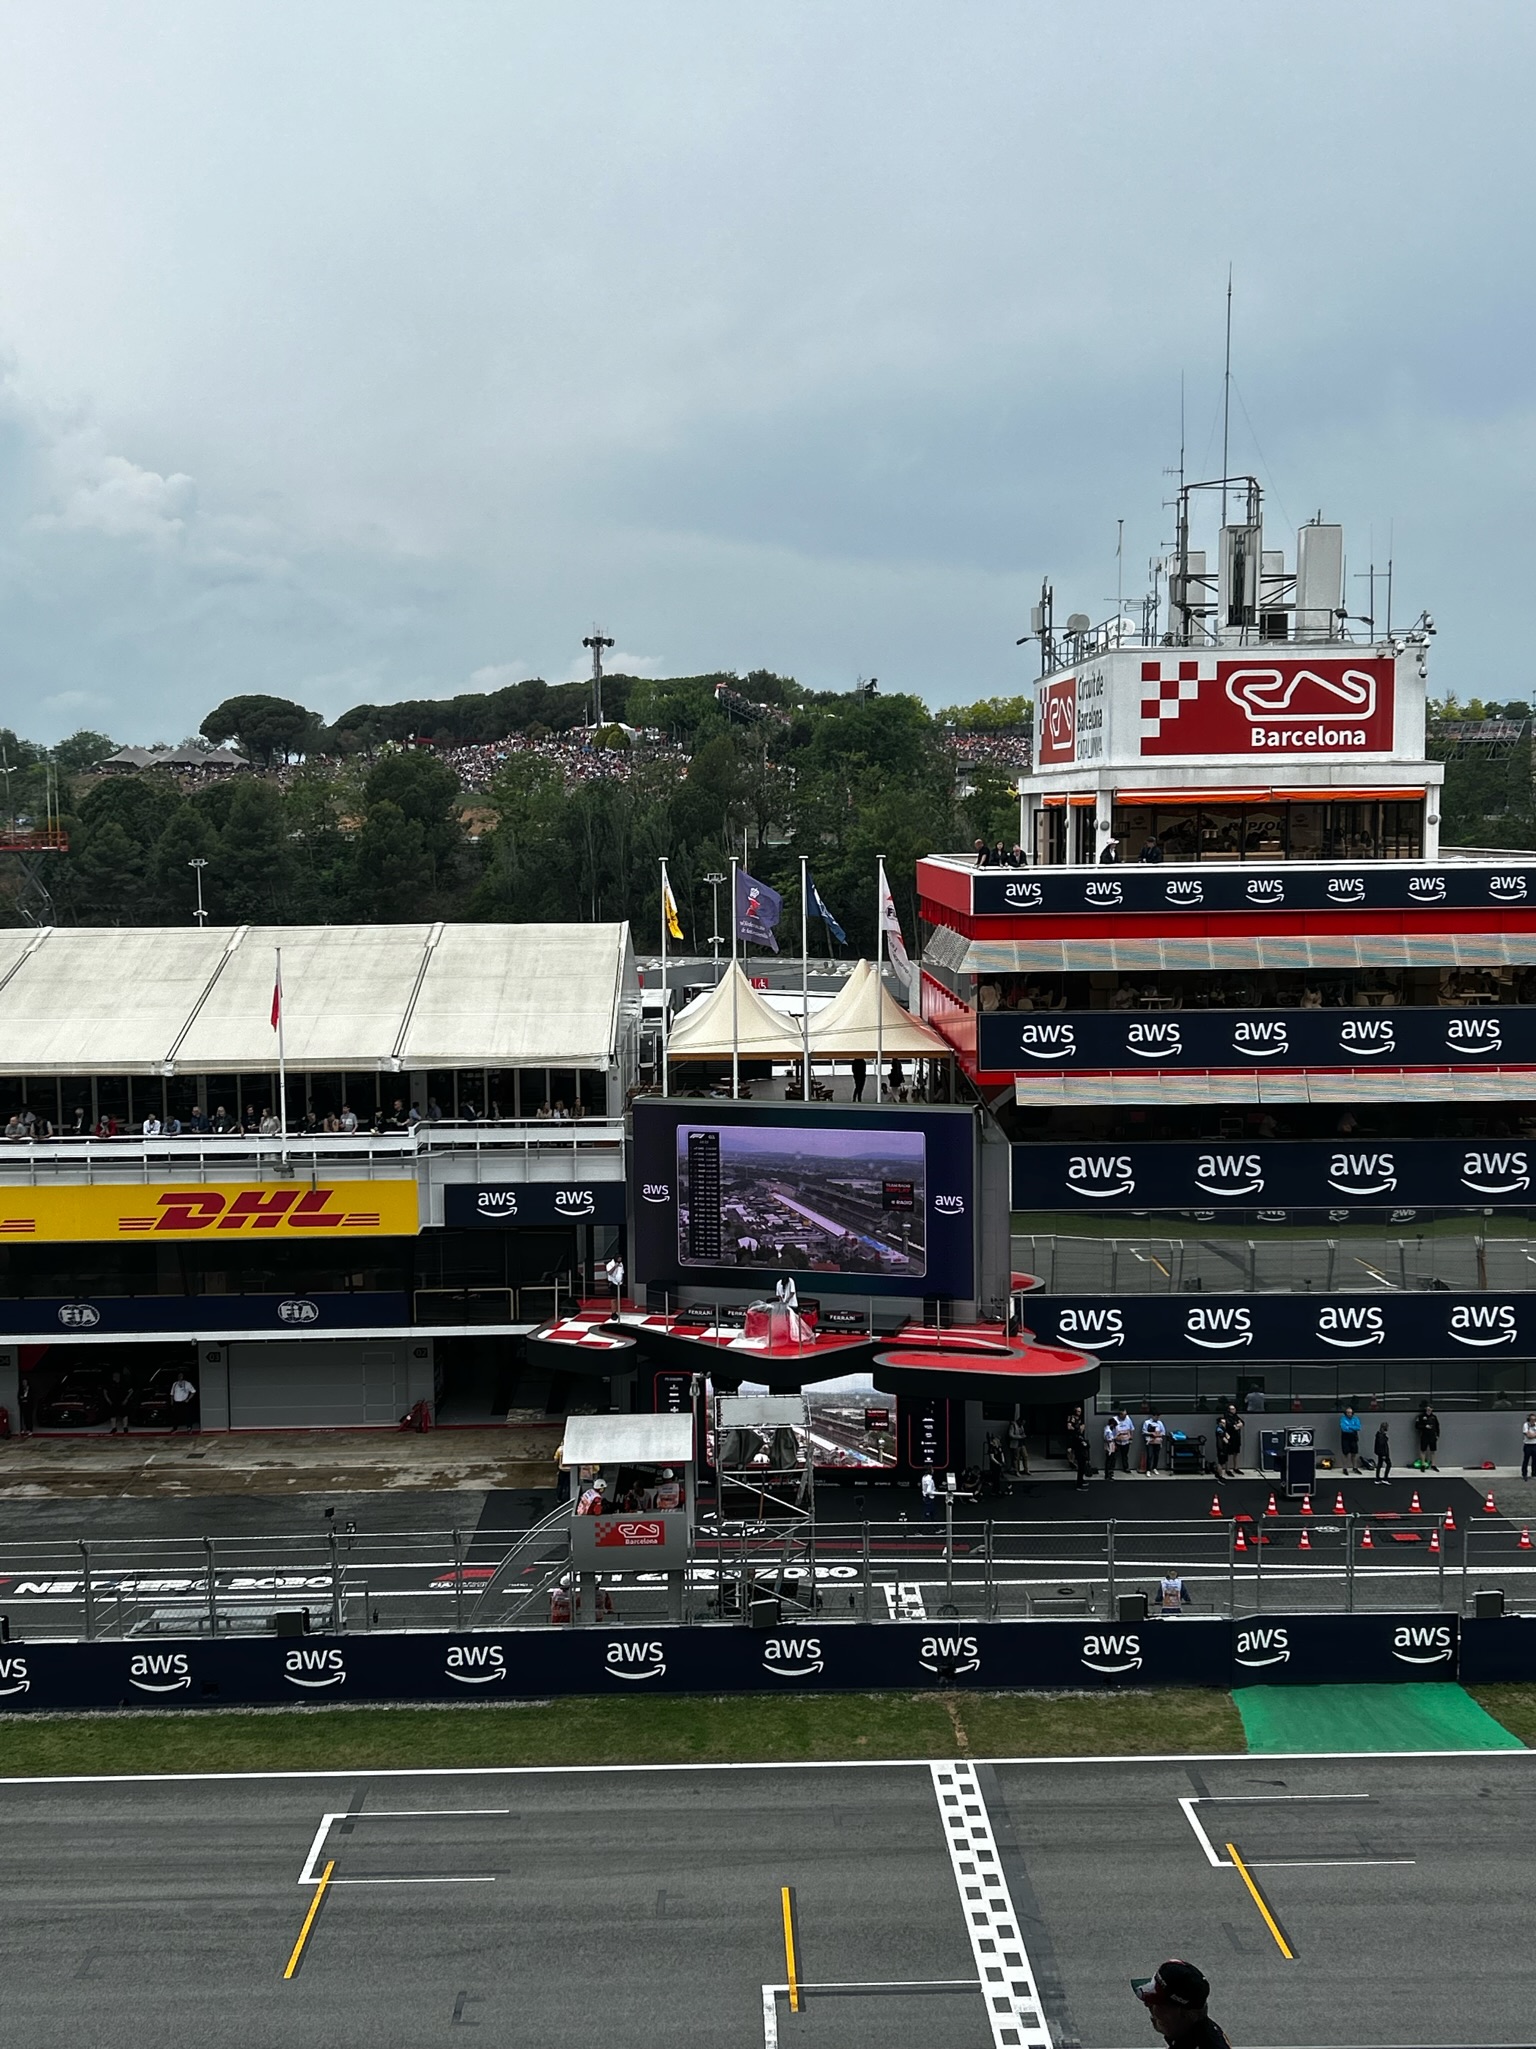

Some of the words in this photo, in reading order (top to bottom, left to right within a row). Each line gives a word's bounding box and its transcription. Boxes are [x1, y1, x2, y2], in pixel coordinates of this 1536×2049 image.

[1077, 706, 1103, 732] Barcelona
[1251, 726, 1366, 747] Barcelona
[1005, 883, 1042, 897] aws
[1085, 882, 1122, 896] aws
[1166, 881, 1203, 895] aws
[1246, 880, 1284, 894] aws
[1327, 879, 1364, 892] aws
[1408, 878, 1446, 891] aws
[1489, 876, 1527, 890] aws
[1022, 1024, 1075, 1043] aws
[1127, 1023, 1181, 1042] aws
[1234, 1022, 1287, 1041] aws
[1341, 1021, 1394, 1040] aws
[1447, 1019, 1501, 1038] aws
[1068, 1156, 1133, 1179] aws
[1197, 1155, 1262, 1178] aws
[1330, 1154, 1395, 1177] aws
[1463, 1152, 1528, 1175] aws
[477, 1191, 517, 1206] aws
[555, 1191, 594, 1205] aws
[642, 1184, 670, 1196] aws
[153, 1189, 346, 1231] DHL
[934, 1195, 964, 1207] aws
[1059, 1309, 1123, 1332] aws
[1187, 1308, 1251, 1331] aws
[1318, 1307, 1383, 1330] aws
[1451, 1305, 1516, 1329] aws
[625, 1537, 658, 1545] Barcelona
[227, 1576, 334, 1590] 2030
[922, 1636, 978, 1657] aws
[1083, 1635, 1140, 1656] aws
[1239, 1628, 1288, 1653] aws
[1395, 1626, 1451, 1647] aws
[446, 1646, 504, 1667] aws
[606, 1642, 664, 1663] aws
[764, 1639, 822, 1660] aws
[130, 1654, 189, 1676] aws
[285, 1650, 344, 1671] aws
